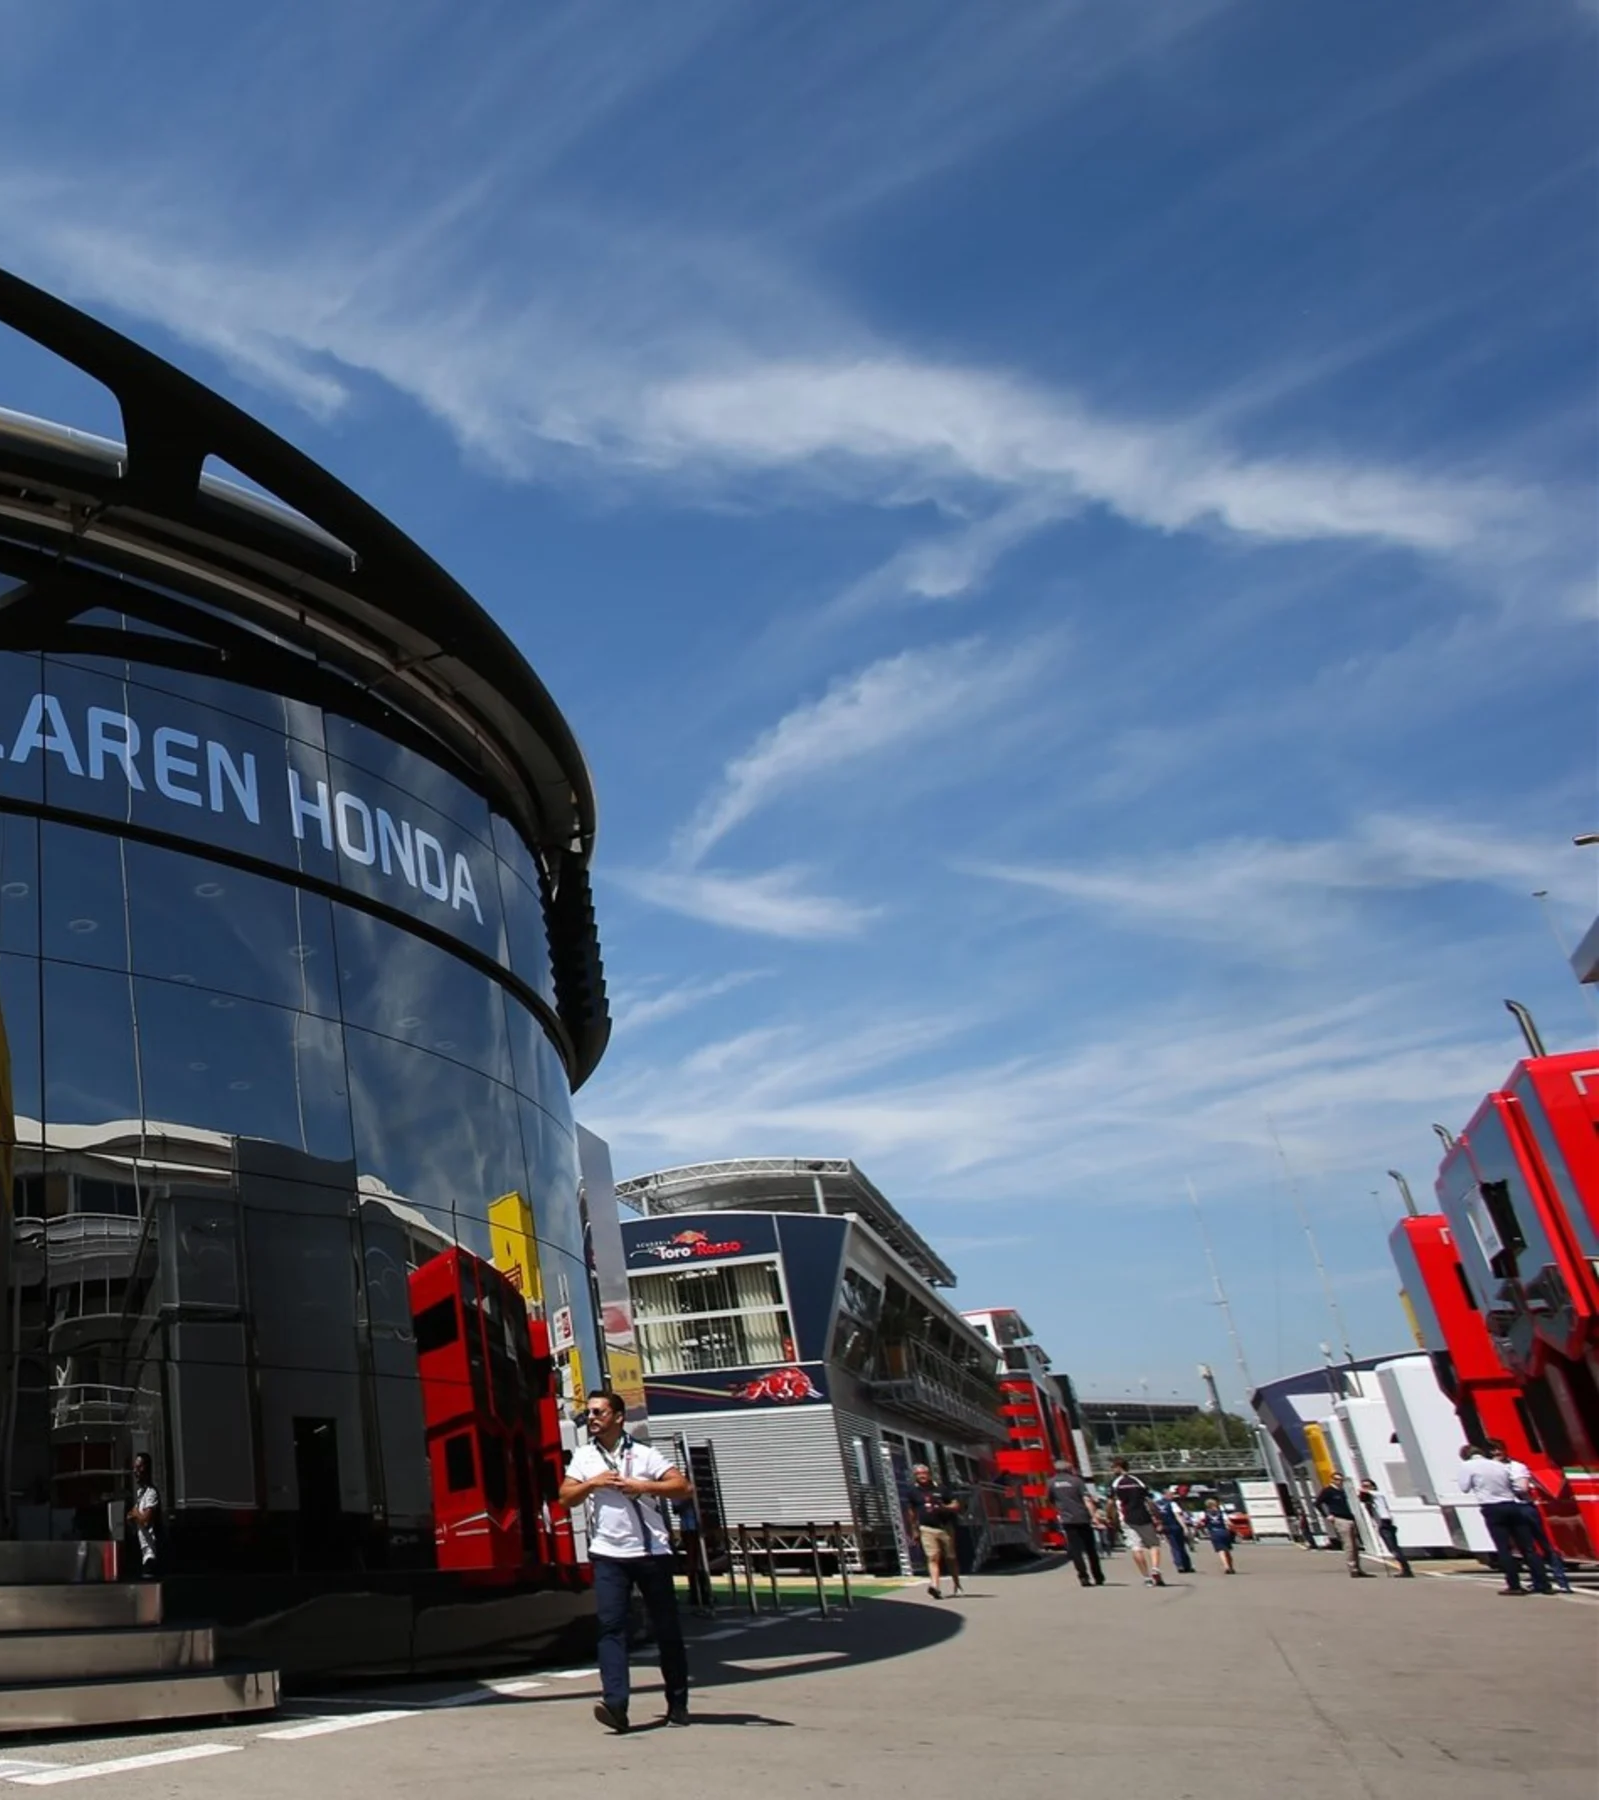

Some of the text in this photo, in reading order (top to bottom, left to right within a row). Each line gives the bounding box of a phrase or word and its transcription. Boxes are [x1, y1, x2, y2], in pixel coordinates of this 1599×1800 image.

[287, 769, 485, 925] HONDA
[657, 1241, 741, 1260] Toro Rosso
